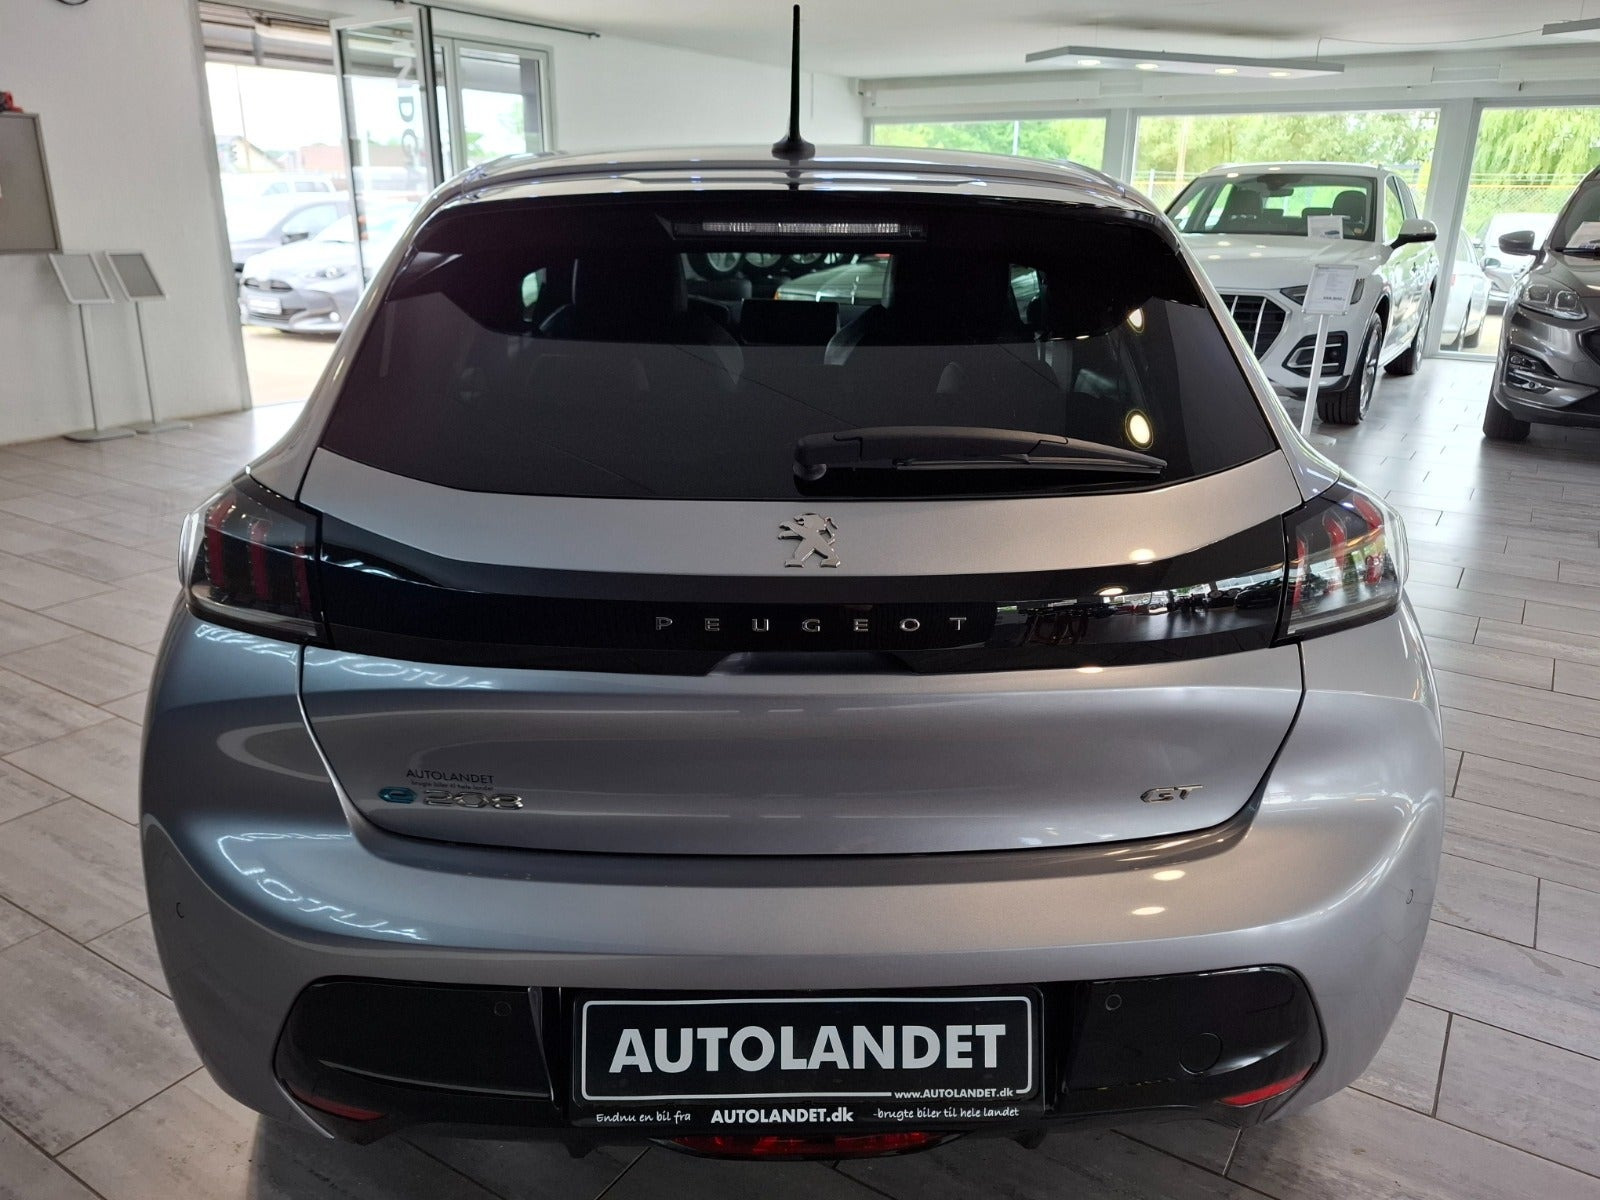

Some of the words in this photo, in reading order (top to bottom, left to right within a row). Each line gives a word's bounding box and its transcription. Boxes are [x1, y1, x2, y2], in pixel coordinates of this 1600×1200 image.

[656, 616, 967, 632] PEUGEOT
[406, 768, 495, 784] AUTOLANDET
[423, 789, 524, 810] 208
[1140, 784, 1204, 803] GT
[608, 1024, 1006, 1074] AUTOLANDET
[894, 1087, 1014, 1099] www.AUTOLANDET.dk
[596, 1111, 637, 1123] Endnu
[639, 1114, 654, 1122] en
[656, 1110, 672, 1122] bil
[673, 1110, 691, 1125] fra
[710, 1106, 854, 1124] AUTOLANDET.dk
[916, 1106, 942, 1119] biler
[943, 1106, 958, 1118] til
[959, 1107, 981, 1118] hele
[983, 1106, 1020, 1117] landet
